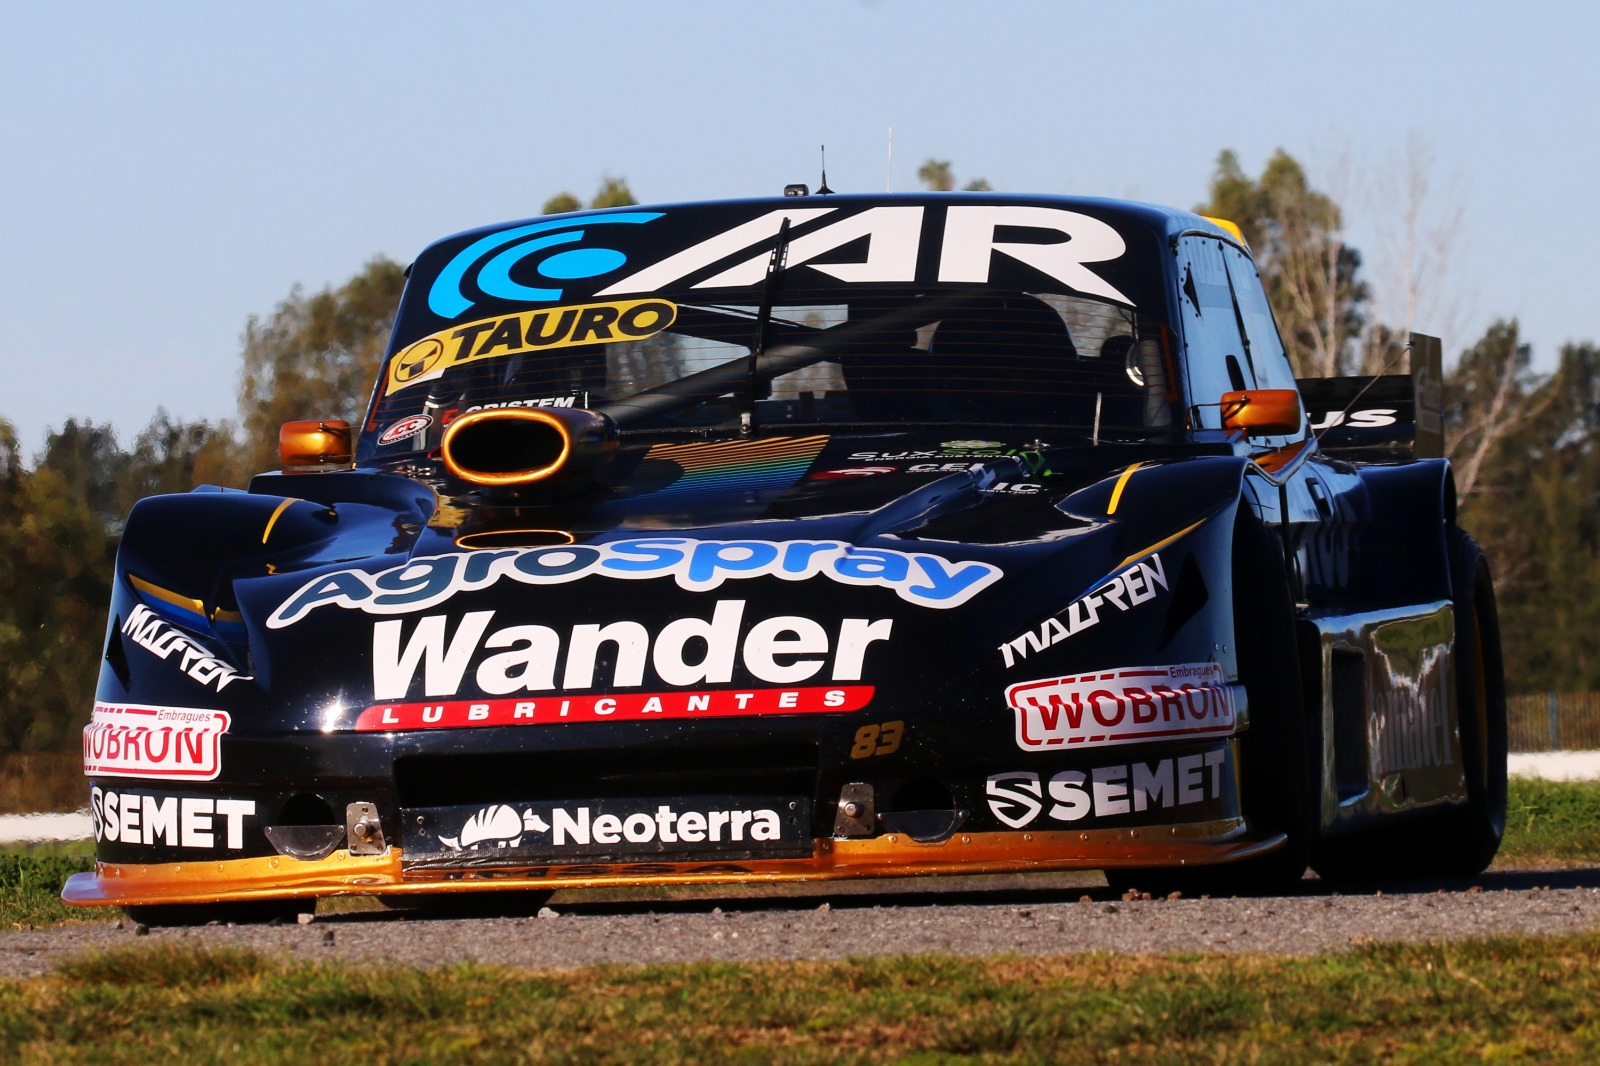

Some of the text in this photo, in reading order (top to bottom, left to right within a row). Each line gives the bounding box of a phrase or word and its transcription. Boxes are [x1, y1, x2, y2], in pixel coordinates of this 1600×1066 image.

[451, 302, 676, 361] TAURO
[998, 553, 1169, 668] MAZFREN
[372, 600, 893, 699] Wander
[1170, 665, 1215, 678] Embragues
[157, 709, 211, 724] Embragues
[380, 688, 847, 725] LUBRICANTES
[1026, 681, 1230, 731] WOBRON
[849, 720, 904, 760] 83
[1048, 749, 1225, 821] SEMET
[103, 791, 256, 849] SEMET
[552, 805, 781, 845] Neoterra
